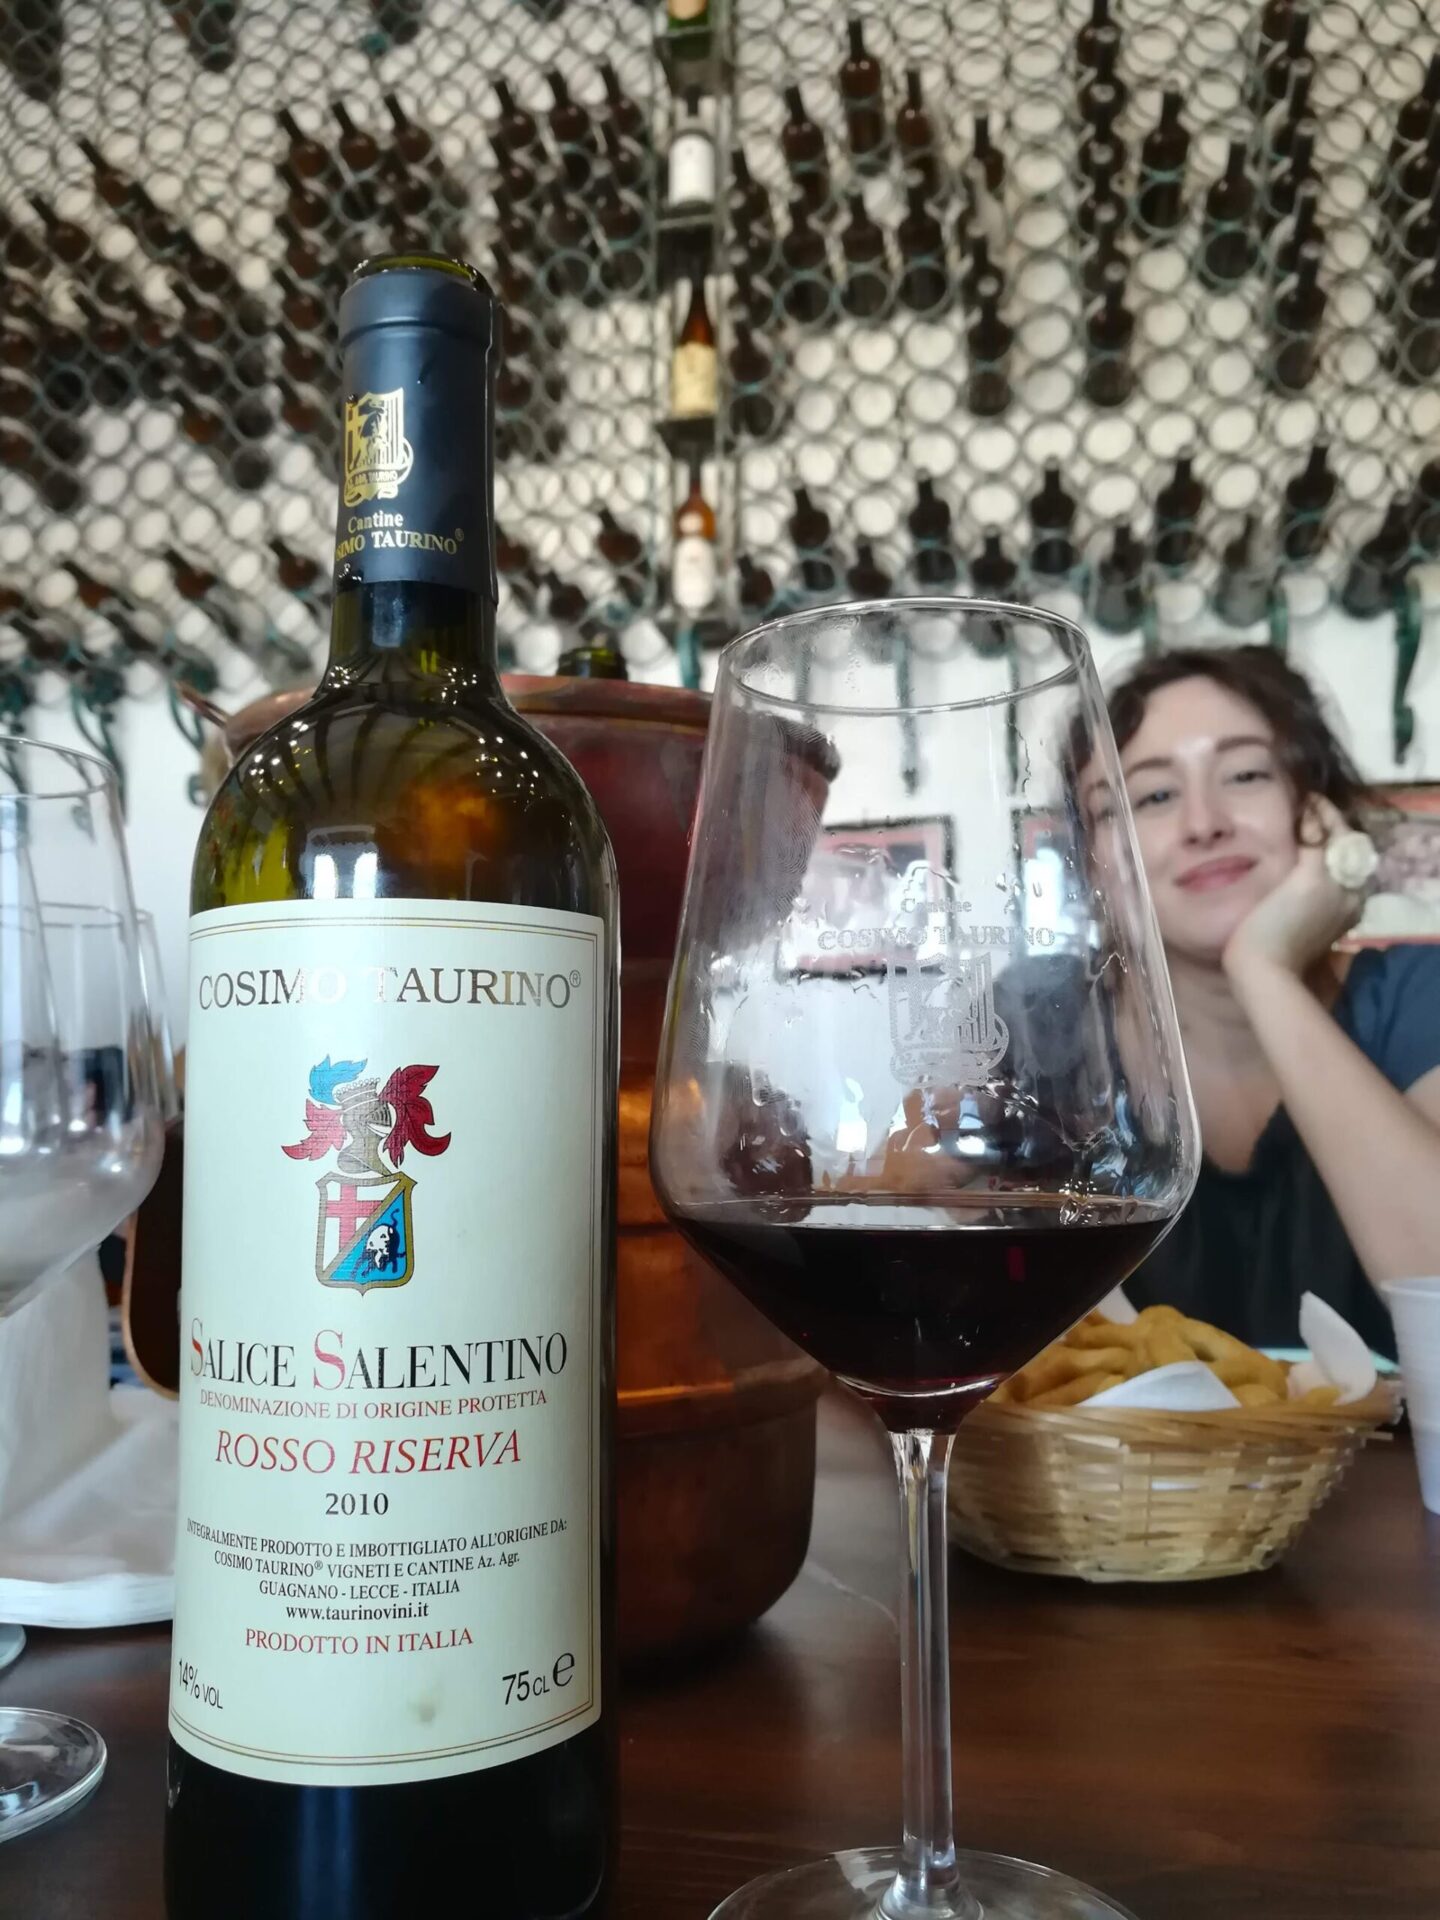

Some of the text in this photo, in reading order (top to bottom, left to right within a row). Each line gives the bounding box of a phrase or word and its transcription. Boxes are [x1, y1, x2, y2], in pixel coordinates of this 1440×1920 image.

[347, 510, 404, 534] Cantine
[817, 925, 1056, 950] COSIMO TAURINO
[199, 967, 348, 1010] COSIMO
[190, 1317, 567, 1391] SALICE SALENTINO
[200, 1388, 548, 1419] DENOMINAZIONE DI ORIGINE PROTETTA
[215, 1429, 521, 1474] ROSSO RISERVA
[325, 1492, 389, 1515] 2010
[186, 1517, 258, 1552] INTEGRALMENTE
[260, 1538, 333, 1558] PRODOTTO
[336, 1543, 346, 1558] E
[349, 1536, 467, 1558] IMBOTTIGLIATO
[550, 1517, 568, 1535] DA:
[214, 1550, 253, 1572] COSIMO
[328, 1563, 390, 1579] VIGNETI
[394, 1563, 404, 1577] E
[407, 1556, 475, 1577] CANTINE
[477, 1554, 496, 1570] Az.
[498, 1550, 520, 1569] Agr.
[259, 1579, 339, 1600] GUAGNANO
[350, 1583, 400, 1600] LECCE
[412, 1578, 461, 1597] ITALIA
[286, 1601, 429, 1621] www.taurinovini.it
[245, 1627, 474, 1655] PRODOTTO IN ITALIA
[202, 1683, 224, 1710] VOL
